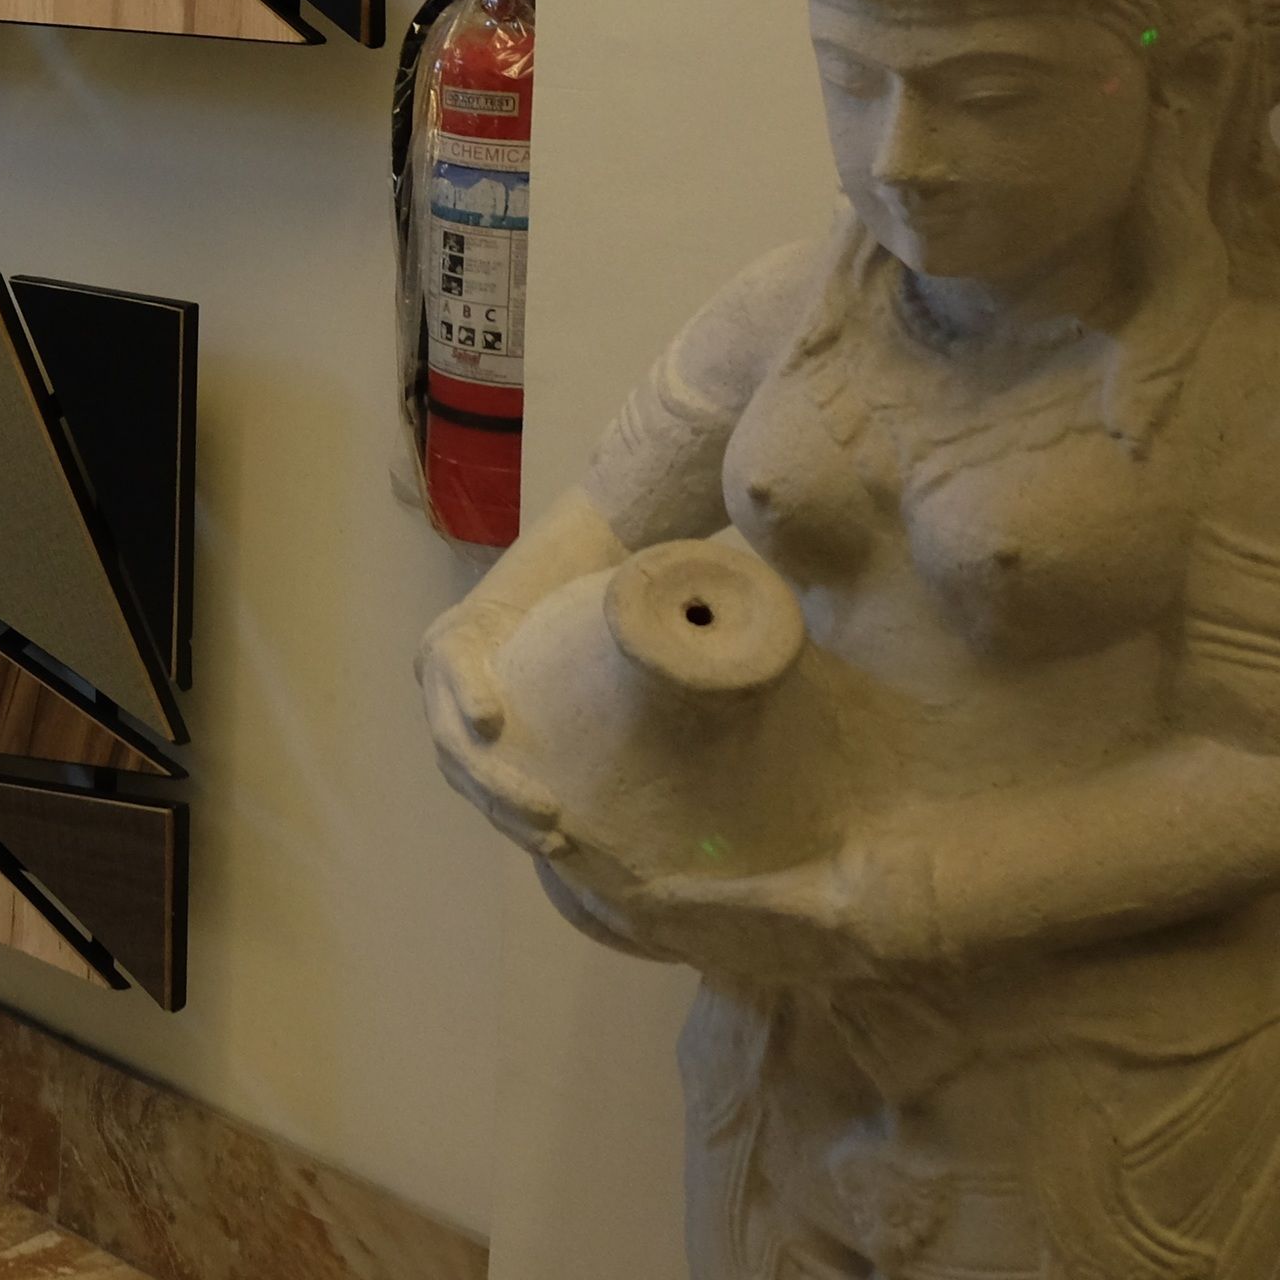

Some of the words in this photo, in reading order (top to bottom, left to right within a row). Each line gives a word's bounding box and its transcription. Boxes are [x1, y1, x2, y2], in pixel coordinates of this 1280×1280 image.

[451, 142, 531, 164] CHEMICA
[462, 304, 472, 319] B
[485, 308, 497, 322] C
